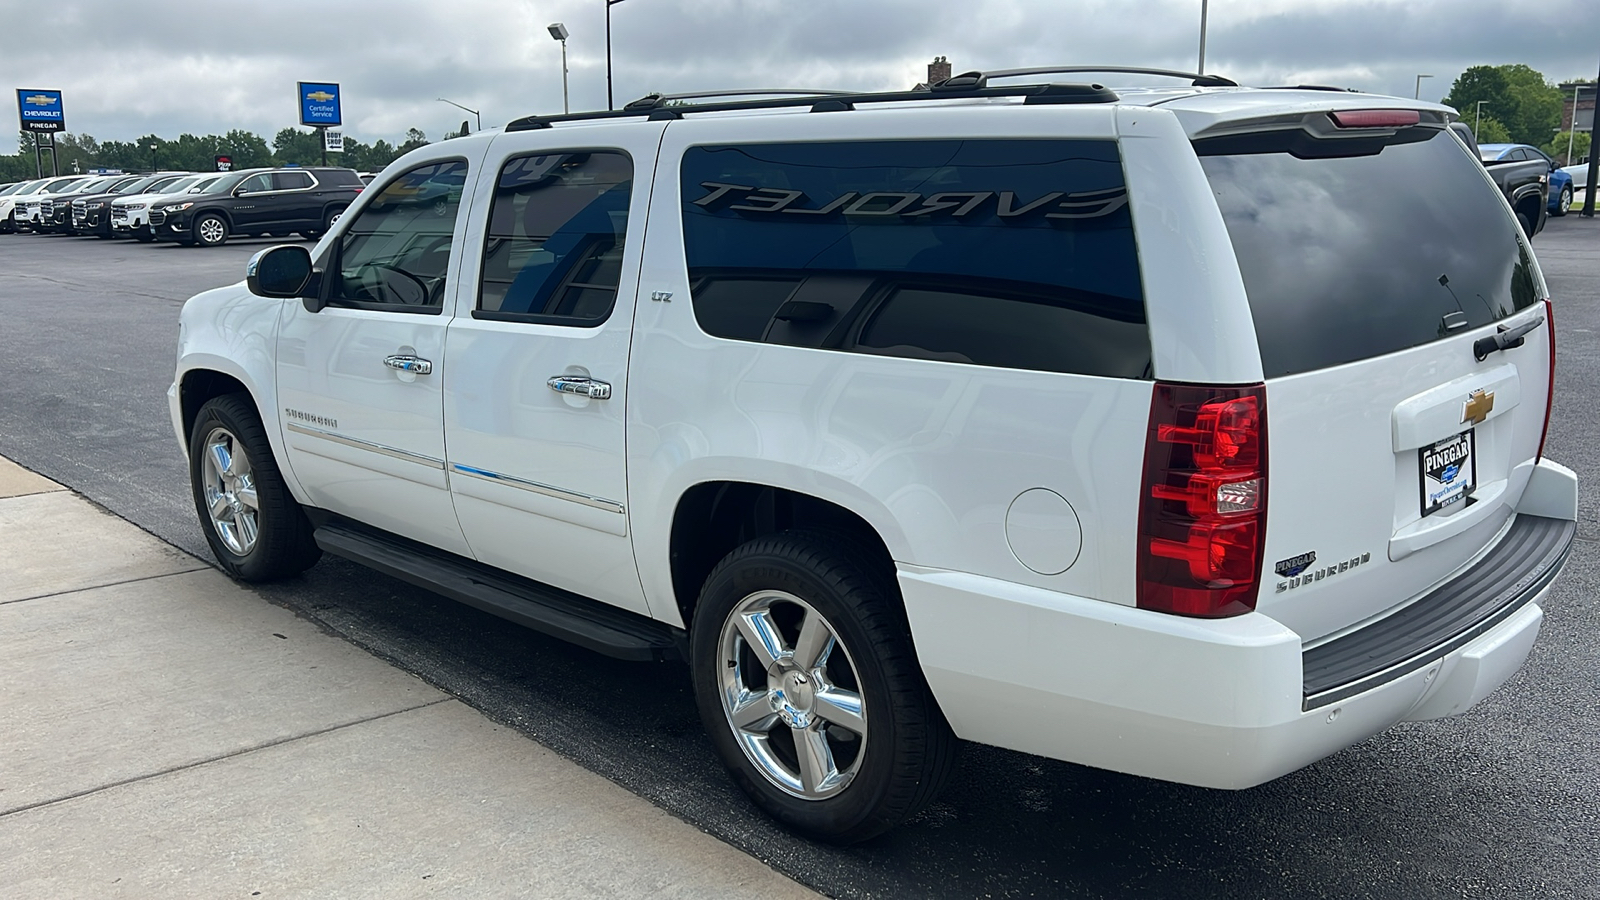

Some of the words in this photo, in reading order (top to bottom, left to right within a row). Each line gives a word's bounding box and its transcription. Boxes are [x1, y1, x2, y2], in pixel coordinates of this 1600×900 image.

[651, 290, 674, 303] LTZ
[284, 408, 338, 428] SUBURBAN
[1425, 441, 1469, 473] PINEGAR
[1275, 551, 1317, 573] PINEGAR
[1275, 552, 1371, 594] SUBURBAN
